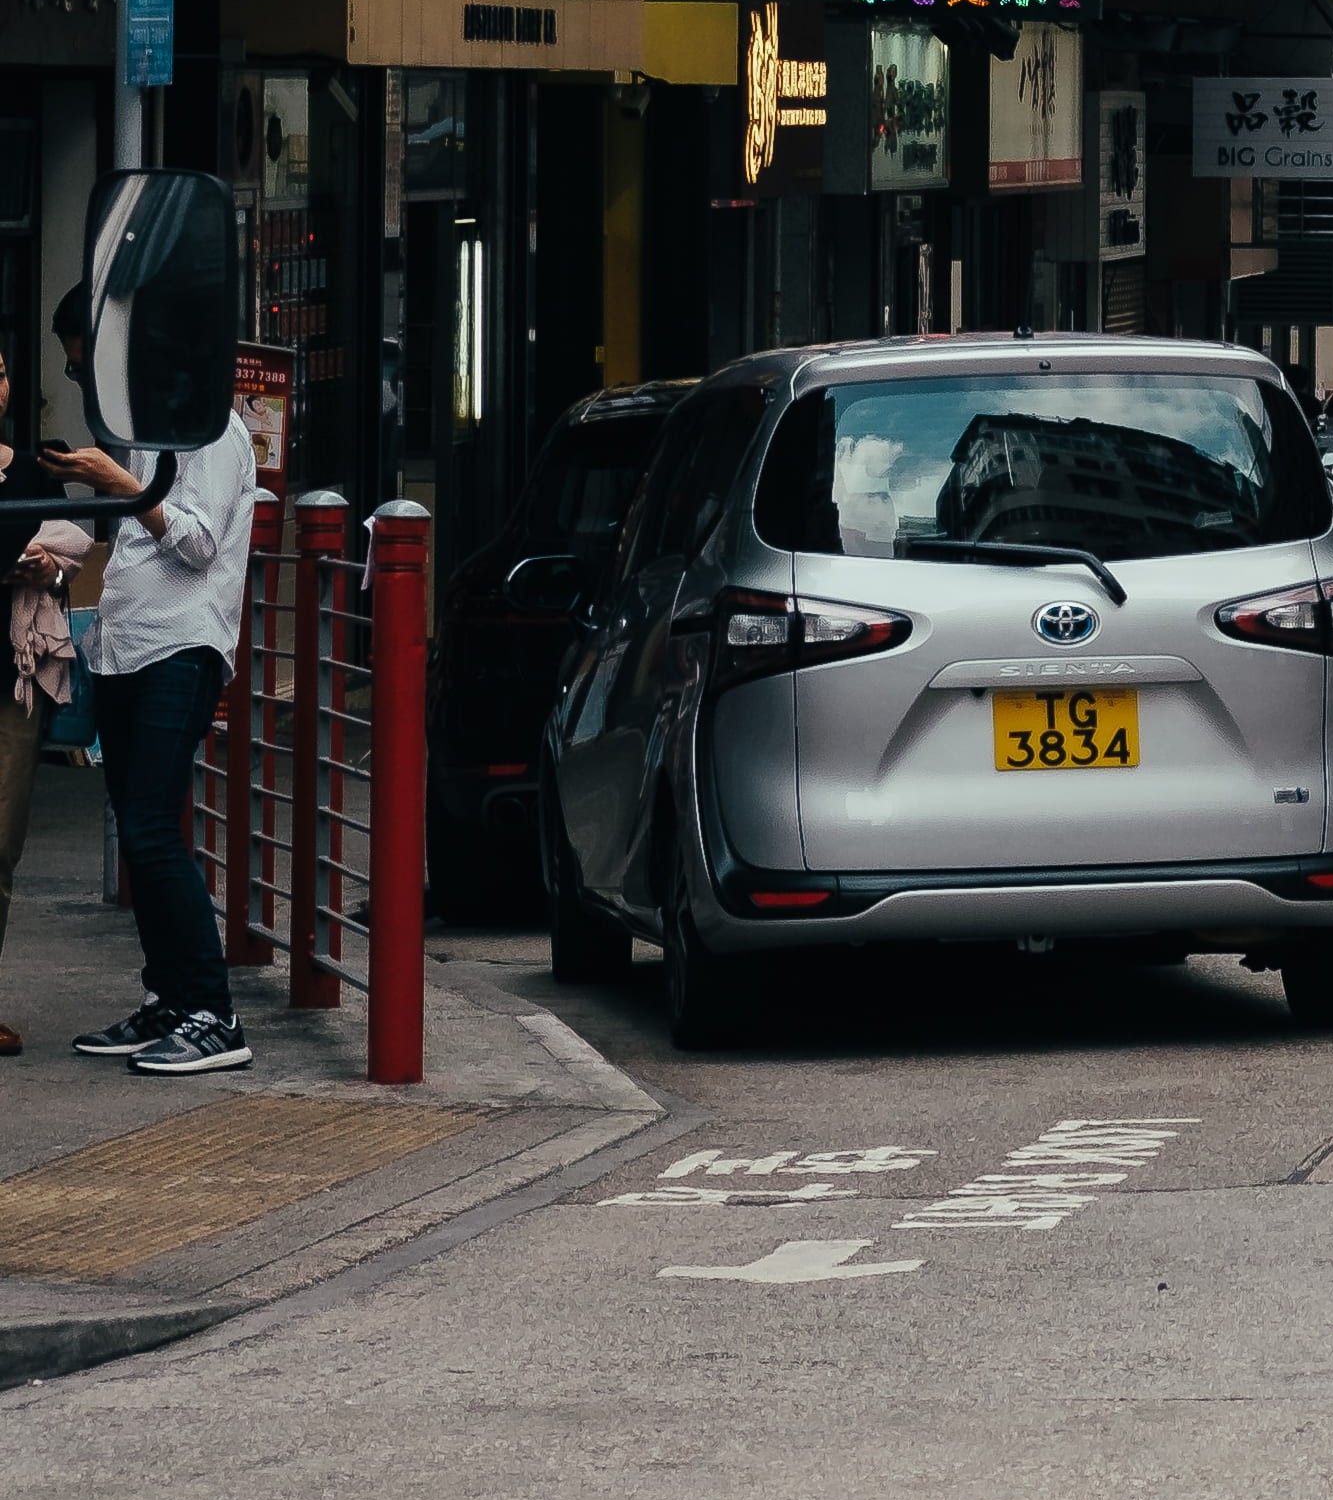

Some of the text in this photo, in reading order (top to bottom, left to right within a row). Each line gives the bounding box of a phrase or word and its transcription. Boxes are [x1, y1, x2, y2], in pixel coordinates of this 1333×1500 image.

[1218, 147, 1333, 168] BIG Grains
[999, 662, 1136, 677] SIENTA
[1036, 691, 1098, 729] TG
[1007, 728, 1130, 768] 3834
